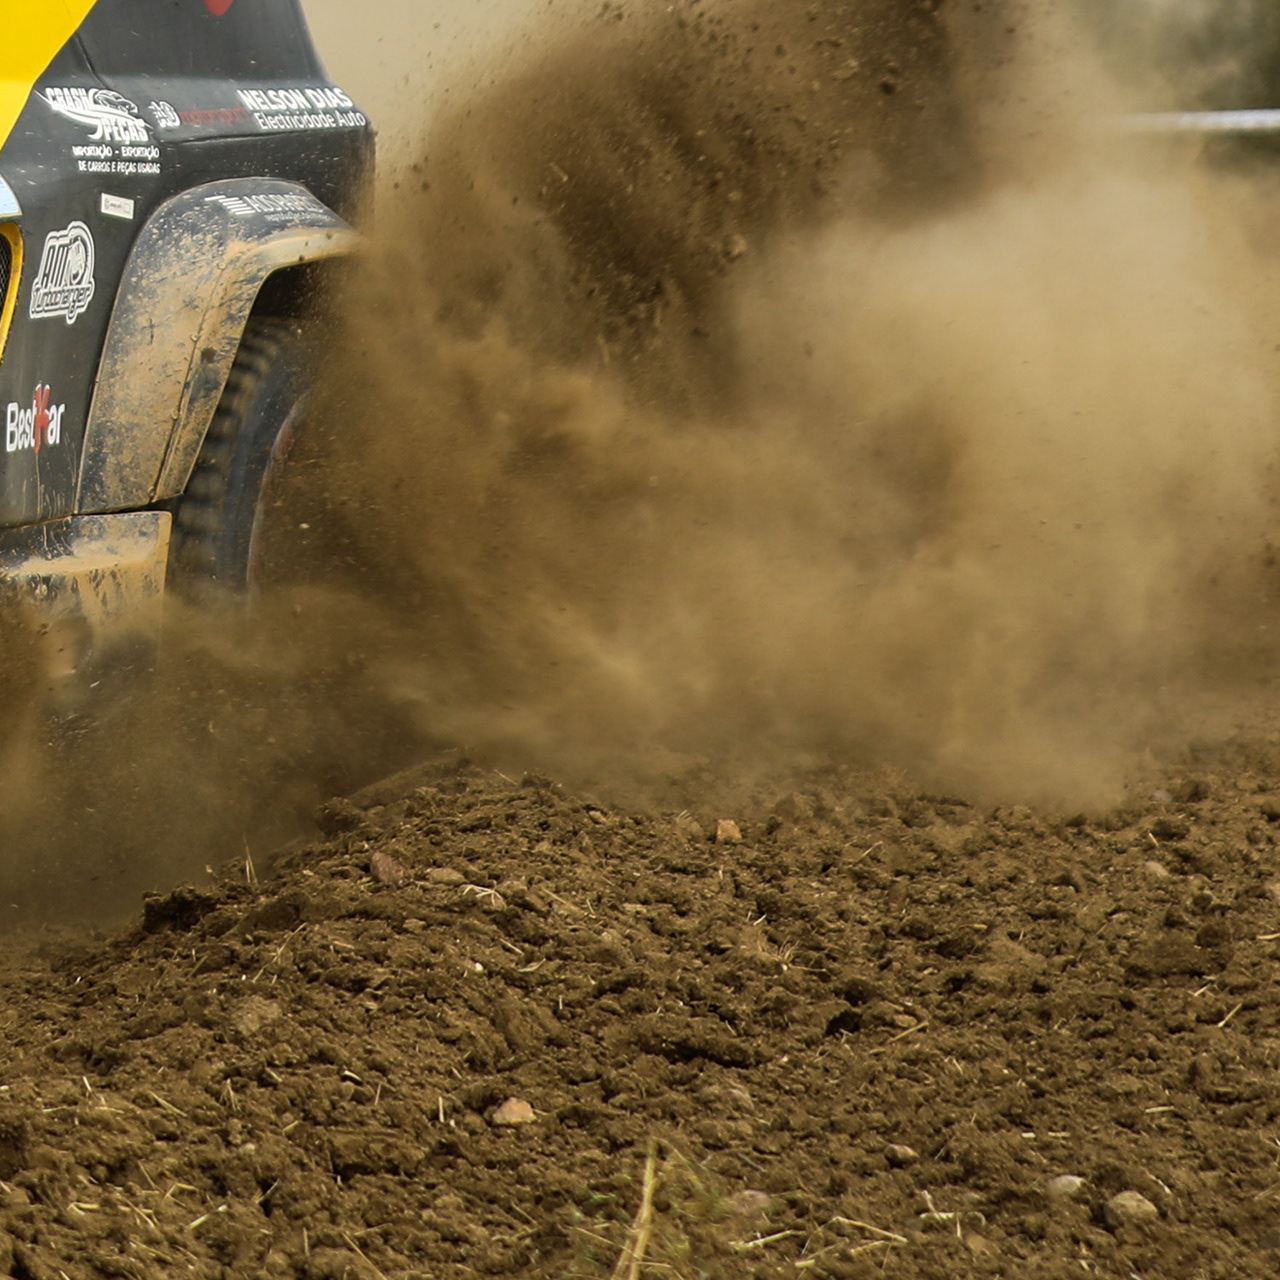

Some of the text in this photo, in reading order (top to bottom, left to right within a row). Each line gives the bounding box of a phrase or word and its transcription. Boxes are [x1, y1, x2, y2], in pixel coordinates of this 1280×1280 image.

[45, 87, 88, 111] CRASH
[237, 87, 354, 110] NELSON DIAS
[253, 111, 337, 129] Electricidade
[339, 111, 366, 127] Auto
